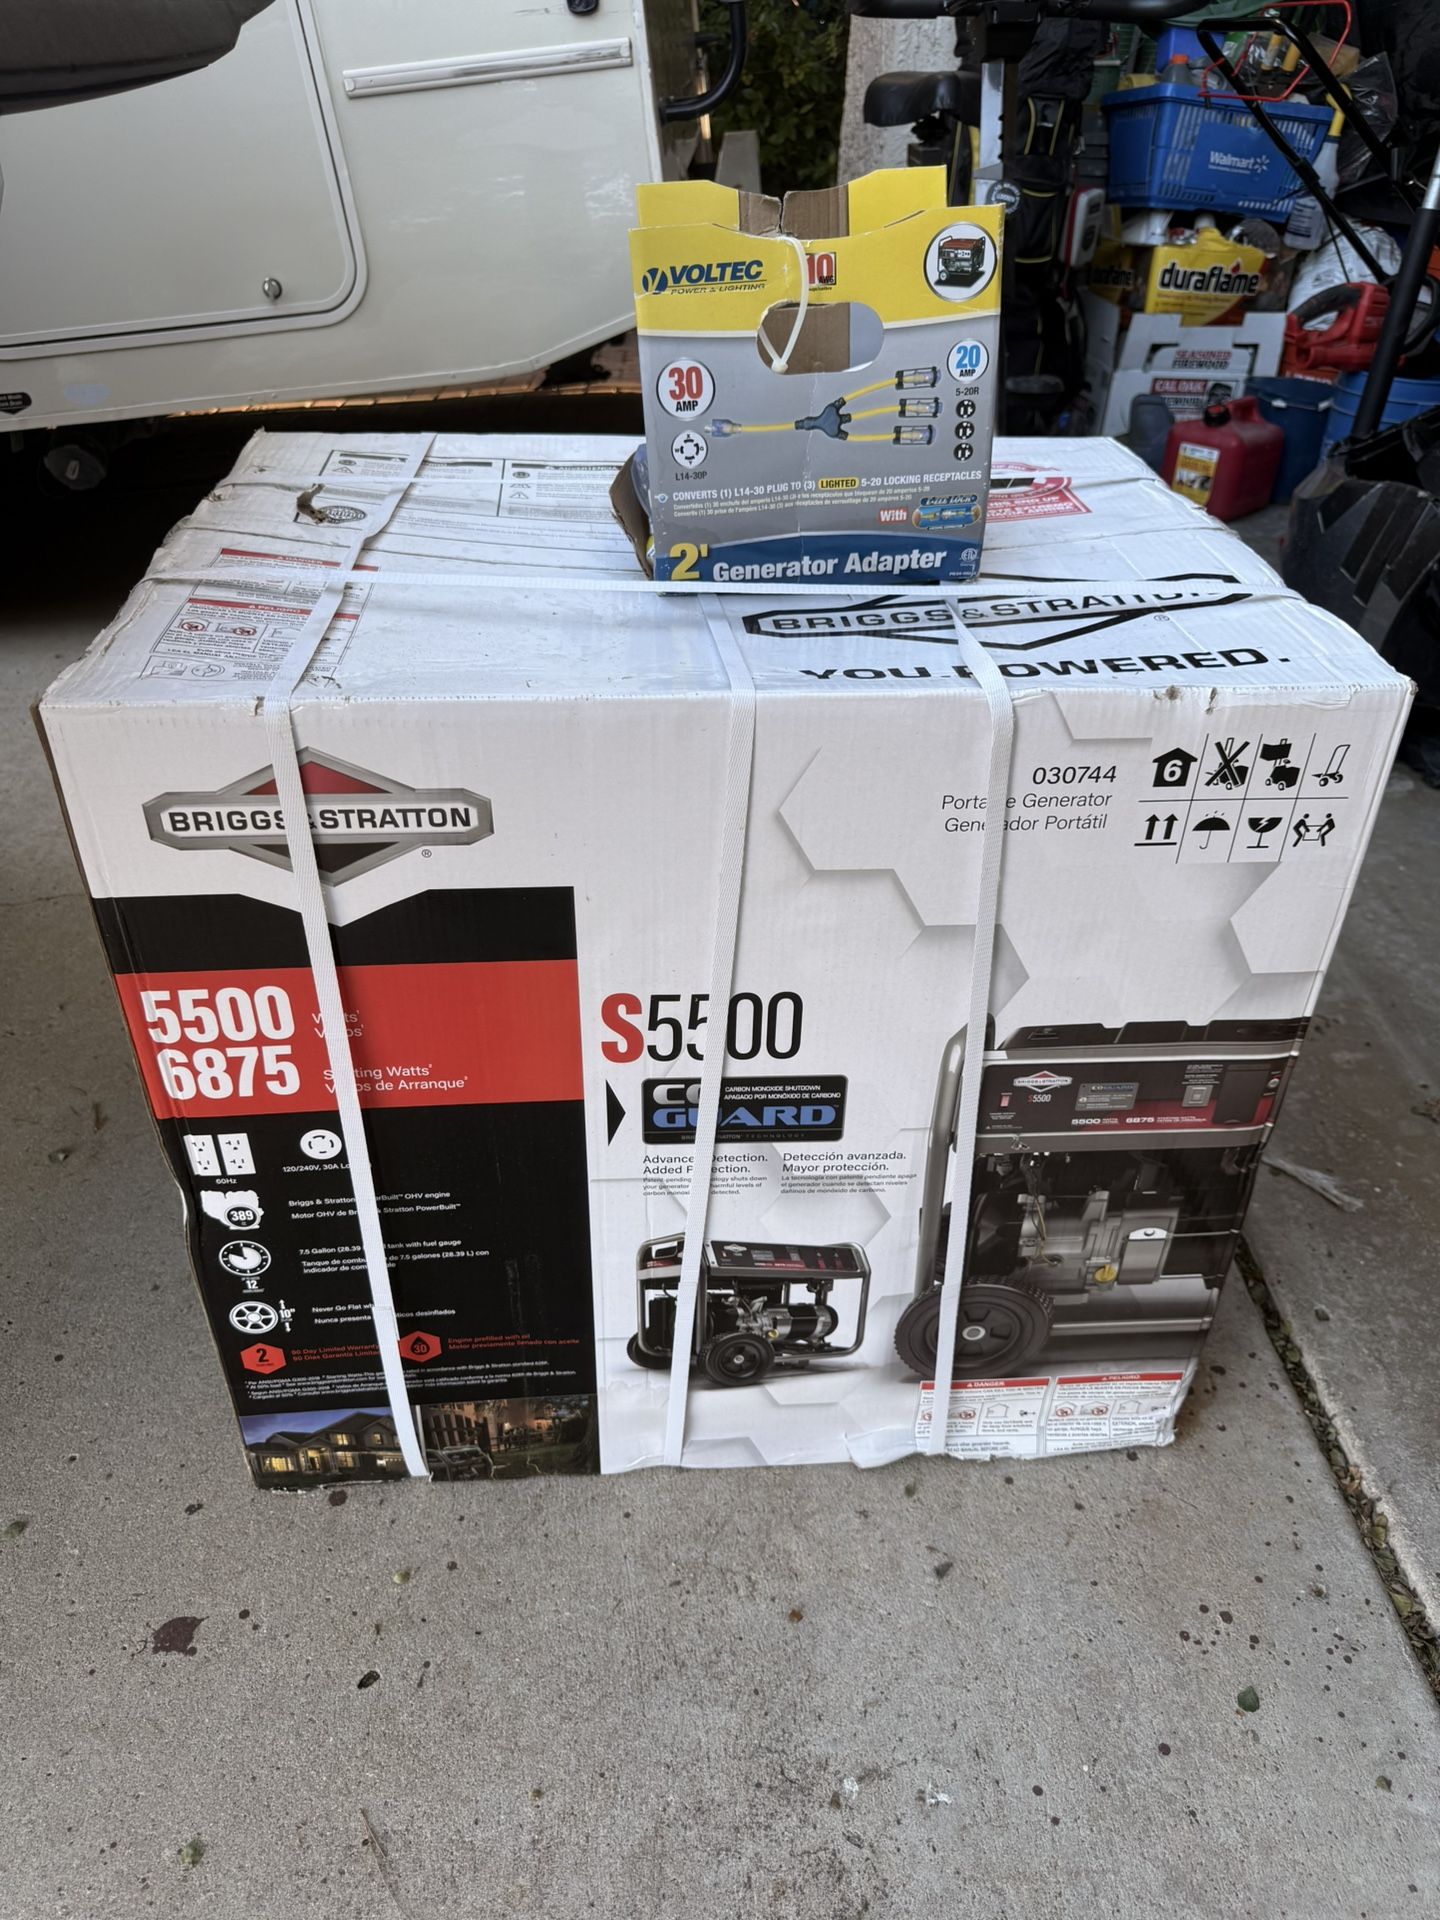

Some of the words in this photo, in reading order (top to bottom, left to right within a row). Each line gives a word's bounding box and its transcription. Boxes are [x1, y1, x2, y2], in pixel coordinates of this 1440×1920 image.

[1209, 151, 1255, 169] Walmart
[669, 259, 764, 285] VOLTEC
[805, 254, 834, 284] 10
[1159, 262, 1260, 294] duraflame
[670, 288, 706, 296] POWER
[719, 283, 766, 292] LIGHTING
[956, 345, 981, 370] 20
[959, 368, 977, 378] AMP
[668, 366, 702, 400] 30
[955, 386, 980, 397] 5-20R
[675, 400, 699, 412] AMP
[675, 471, 708, 481] L14-30P
[673, 489, 718, 501] CONVERTS
[720, 488, 732, 500] (1)
[734, 486, 765, 498] L14-30
[767, 482, 789, 493] PLUG
[790, 481, 801, 491] TO
[803, 480, 816, 491] (3)
[820, 478, 857, 489] LIGHTED
[861, 477, 882, 487] 5-20
[883, 475, 921, 486] LOCKING
[923, 470, 982, 483] RECEPTACLES
[880, 509, 907, 522] With
[669, 543, 708, 580] 2'
[713, 556, 837, 582] Generator
[843, 549, 948, 577] Adapter
[772, 609, 954, 630] BRIGGS
[961, 608, 990, 620] &
[1032, 765, 1116, 785] 030744
[1162, 760, 1182, 783] 6
[942, 794, 1016, 810] Portae
[1022, 792, 1112, 809] Generator
[168, 810, 287, 832] BRIGGS
[319, 807, 471, 830] STRATTON
[1044, 813, 1108, 832] Portátil
[140, 985, 295, 1045] 5500
[601, 991, 803, 1064] S5500
[156, 1045, 300, 1101] 6875
[375, 1080, 394, 1092] de
[724, 1085, 750, 1093] CARBON
[785, 1084, 821, 1092] SHUTDOWN
[723, 1093, 753, 1101] APAGADO
[753, 1092, 767, 1100] POR
[768, 1091, 801, 1099] MONÓXIDO
[811, 1091, 841, 1099] CARBONO
[1027, 1094, 1052, 1103] S5500
[1126, 1116, 1155, 1124] 6875
[642, 1154, 695, 1164] Advance
[783, 1152, 844, 1162] Detección
[846, 1150, 906, 1161] avanzada.
[282, 1164, 322, 1173] 120/240V,
[323, 1162, 339, 1171] 30A
[643, 1165, 683, 1175] Added
[782, 1163, 819, 1174] Mayor
[822, 1162, 889, 1174] protección.
[288, 1199, 315, 1207] Briggs
[324, 1197, 356, 1205] Stratton
[424, 1191, 451, 1199] engine
[229, 1210, 254, 1221] 389
[291, 1211, 315, 1220] Motor
[383, 1206, 415, 1214] Stratton
[311, 1247, 336, 1255] Gallon
[337, 1245, 361, 1253] (28.39
[405, 1241, 422, 1249] with
[438, 1239, 462, 1248] gauge
[301, 1260, 330, 1269] Tanque
[411, 1252, 441, 1260] galones
[442, 1250, 465, 1258] (28.39
[303, 1265, 338, 1274] Indicador
[246, 1279, 259, 1289] 12
[312, 1306, 334, 1314] Never
[314, 1317, 339, 1325] Nunca
[340, 1314, 372, 1324] presenta
[415, 1308, 456, 1317] desinflados
[319, 1346, 346, 1354] Limited
[413, 1344, 428, 1353] 30
[471, 1340, 515, 1350] previamente
[256, 1348, 270, 1363] 2
